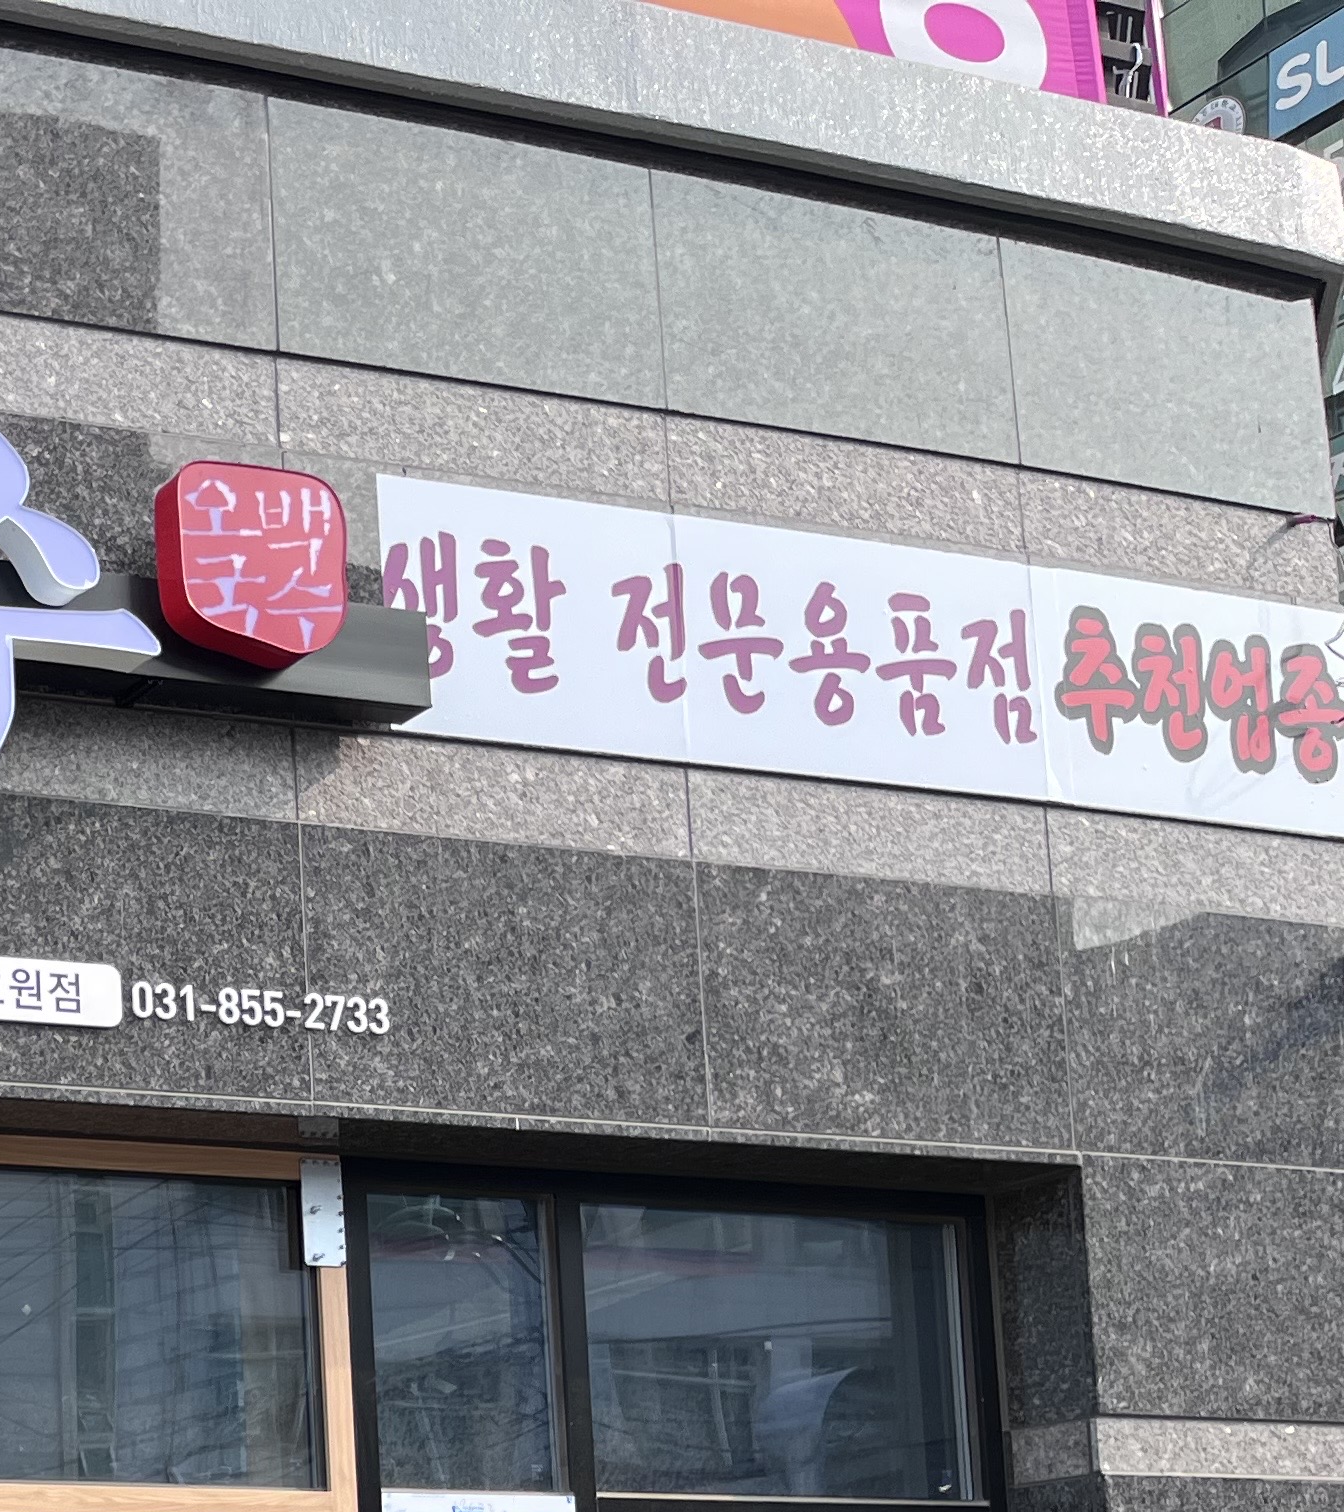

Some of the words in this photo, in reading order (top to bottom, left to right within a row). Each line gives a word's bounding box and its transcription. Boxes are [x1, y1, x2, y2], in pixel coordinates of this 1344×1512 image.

[183, 479, 332, 574] 오백
[187, 555, 343, 650] 국수
[383, 530, 566, 694] 생활
[612, 563, 1038, 744] 전문용품점
[1055, 606, 1344, 783] 추천업종
[132, 981, 391, 1035] 031-855-2733
